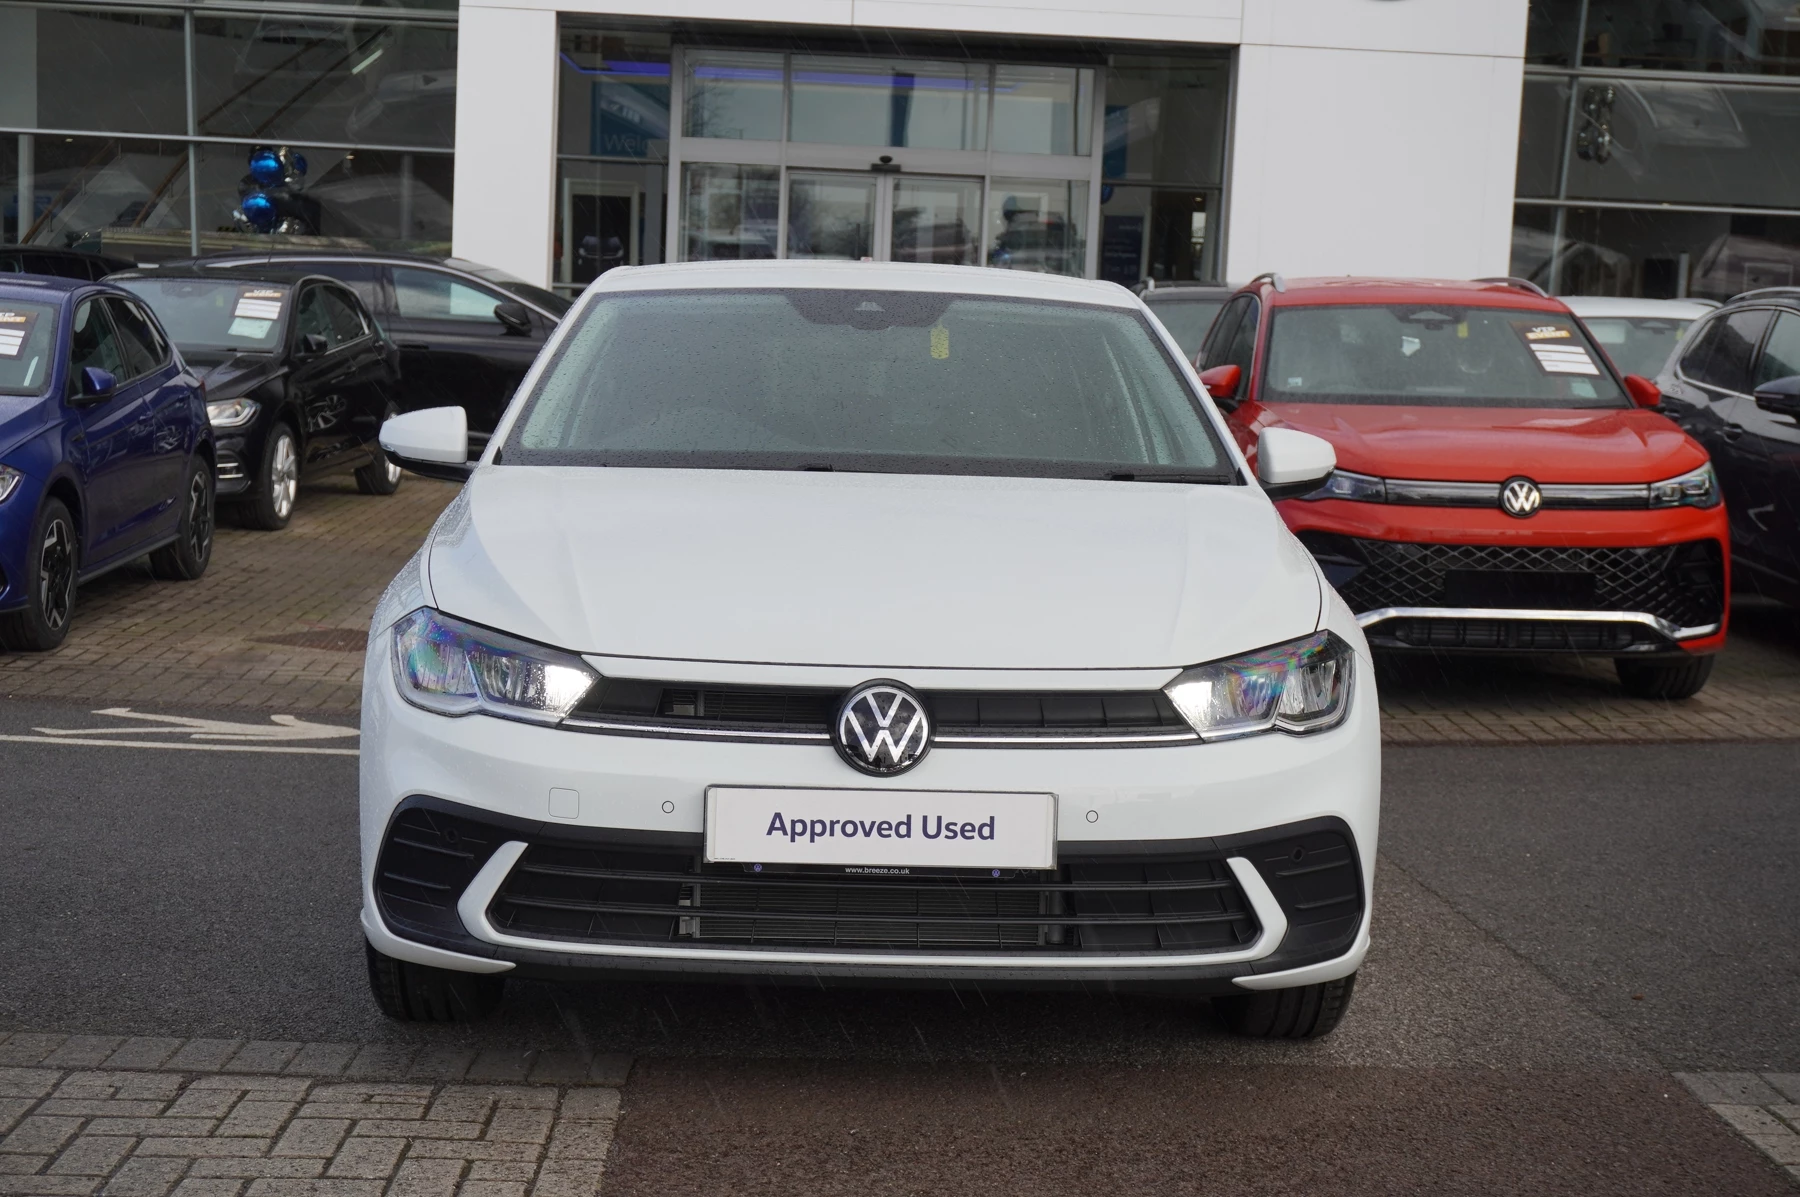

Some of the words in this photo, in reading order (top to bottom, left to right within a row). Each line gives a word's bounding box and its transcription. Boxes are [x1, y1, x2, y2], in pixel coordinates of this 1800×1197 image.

[841, 687, 927, 768] VW
[766, 812, 912, 843] Approved
[921, 815, 995, 841] Used
[845, 866, 910, 875] www.breeze.co.uk
